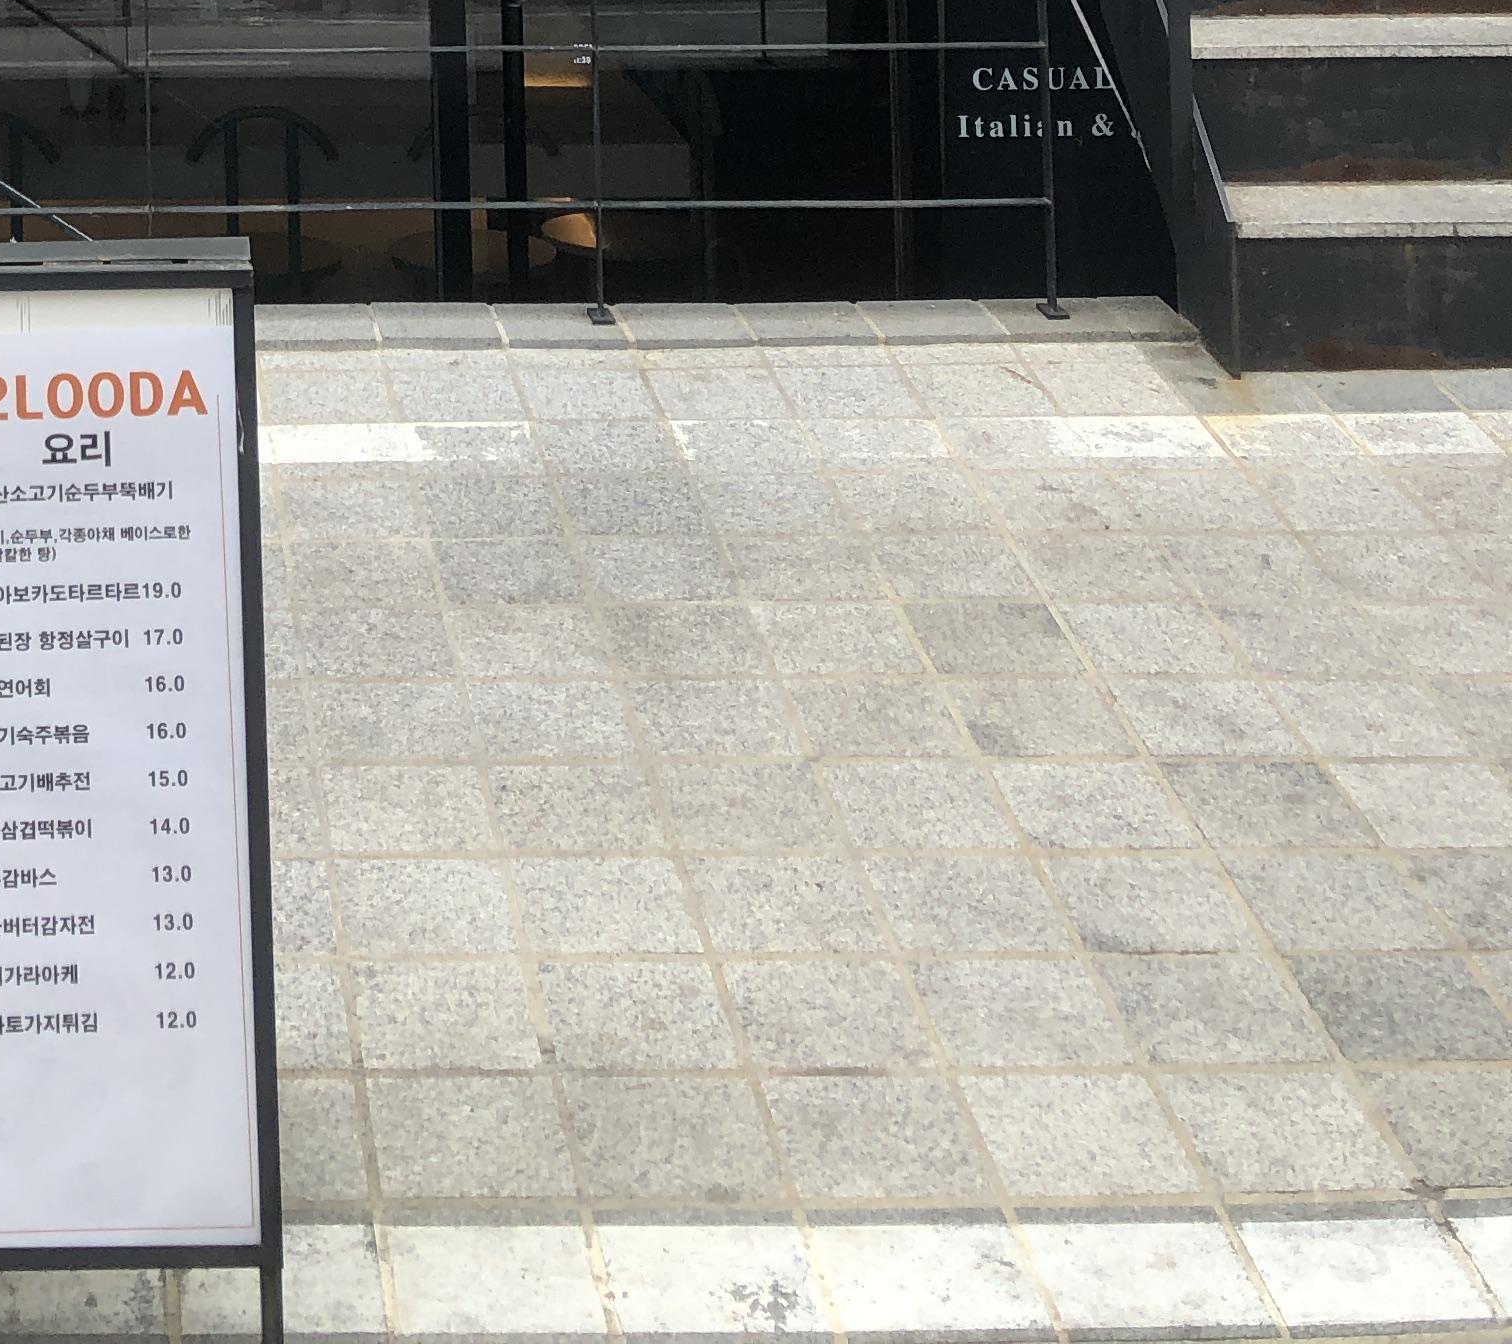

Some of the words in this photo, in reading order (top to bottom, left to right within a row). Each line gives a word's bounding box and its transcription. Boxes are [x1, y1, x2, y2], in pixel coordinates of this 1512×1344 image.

[972, 66, 1116, 91] CASUAL
[1091, 112, 1114, 137] &
[43, 431, 111, 467] 요리
[39, 629, 128, 650] 항정살구이
[144, 629, 182, 645] 17.0
[145, 675, 184, 692] 16.0
[147, 723, 186, 739] 16.0
[148, 770, 187, 787] 15.0
[150, 818, 189, 834] 14.0
[152, 865, 191, 882] 13.0
[154, 913, 193, 931] 13.0
[155, 962, 195, 979] 12.0
[157, 1011, 196, 1028] 12.0
